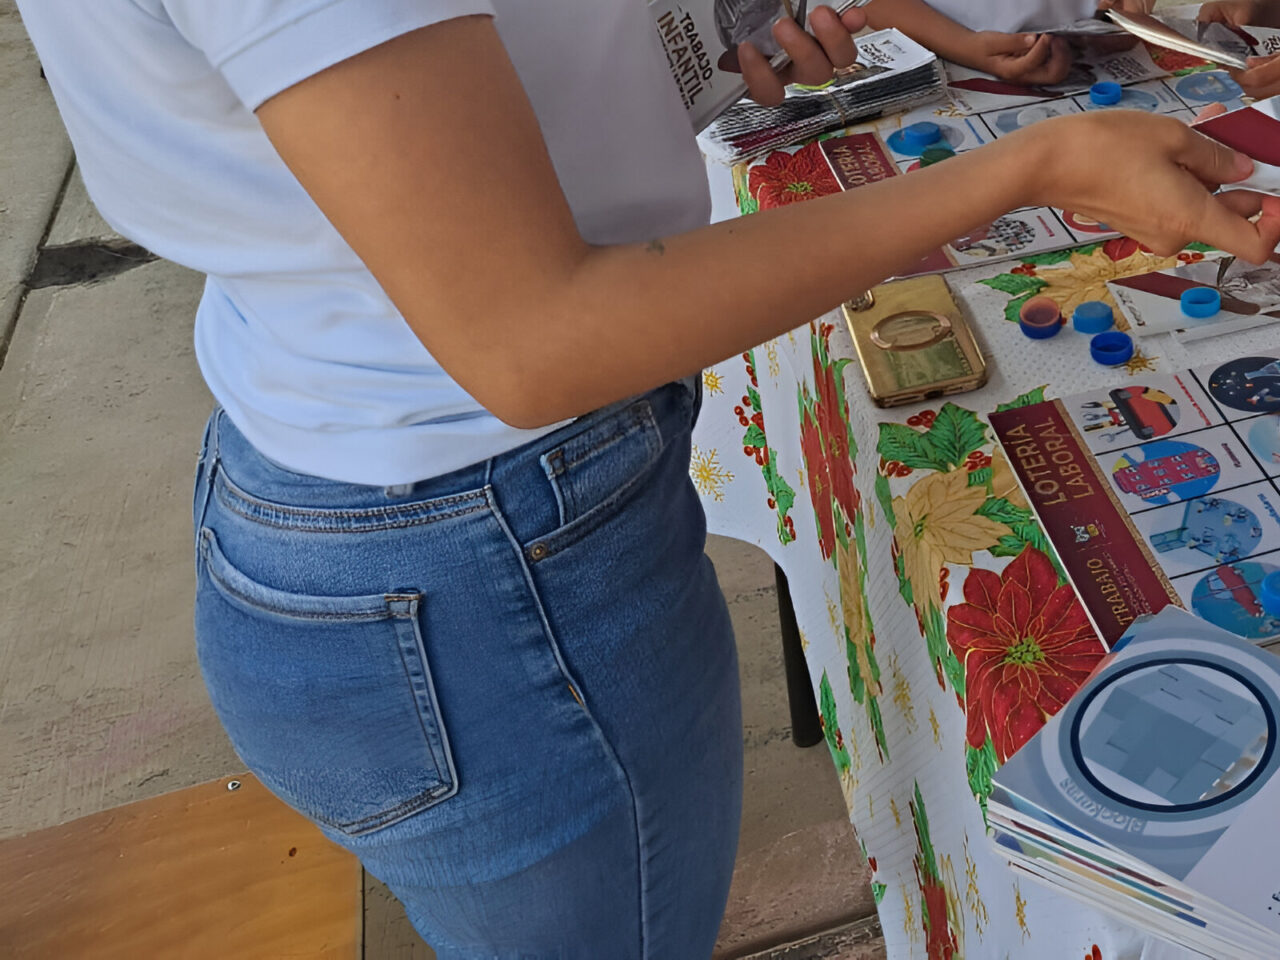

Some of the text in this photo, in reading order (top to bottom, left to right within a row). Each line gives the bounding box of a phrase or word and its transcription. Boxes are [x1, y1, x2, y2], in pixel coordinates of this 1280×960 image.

[656, 10, 703, 106] INFANTIL
[678, 11, 714, 82] TRABAJO
[1003, 423, 1067, 504] LOTERÍA
[1033, 416, 1094, 496] LABORAL
[1085, 556, 1133, 626] TRABAJO
